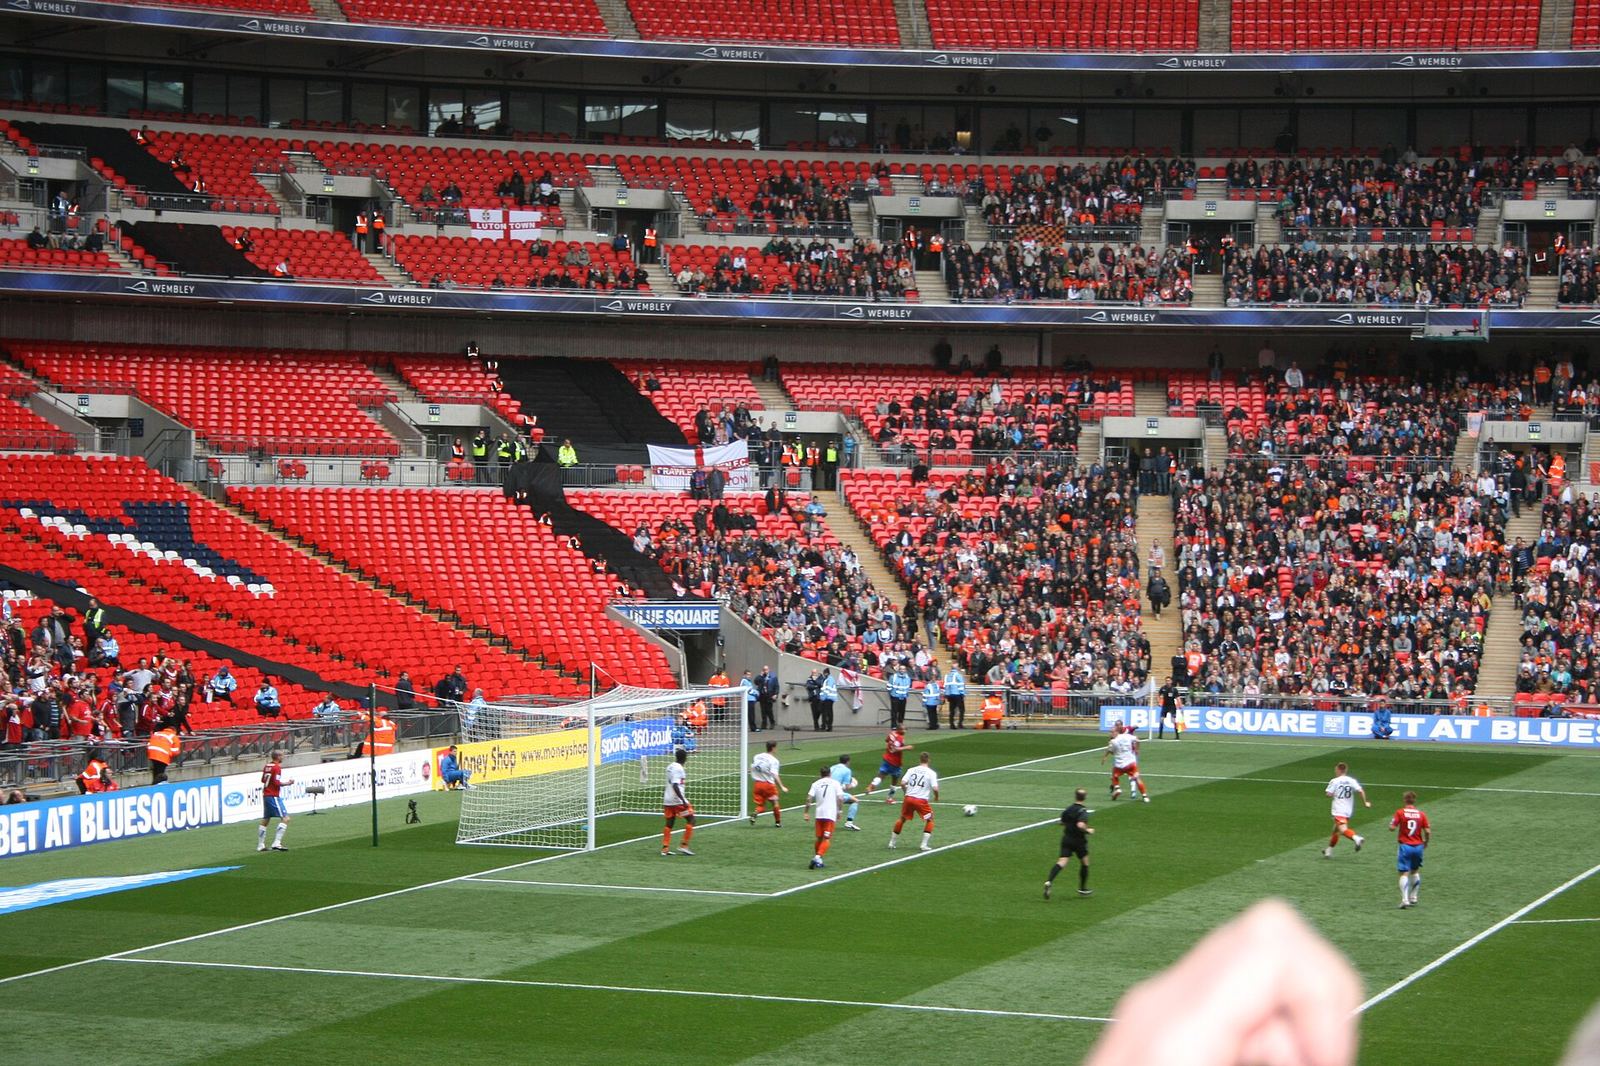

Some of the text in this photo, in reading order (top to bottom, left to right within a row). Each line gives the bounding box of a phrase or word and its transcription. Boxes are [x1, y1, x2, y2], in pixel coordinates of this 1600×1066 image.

[34, 2, 76, 13] WEMBLEY
[264, 23, 306, 34] WEMBLEY
[493, 39, 535, 49] WEMBLEY
[721, 50, 764, 59] WEMBLEY
[952, 57, 994, 65] WEMBLEY
[1183, 60, 1226, 68] WEMBLEY
[1418, 57, 1462, 66] WEMBLEY
[509, 222, 536, 230] TOWN
[151, 284, 195, 294] WEMBLEY
[388, 295, 433, 304] WEMBLEY
[627, 302, 672, 311] WEMBLEY
[867, 309, 912, 318] WEMBLEY
[1111, 313, 1156, 322] WEMBLEY
[1357, 315, 1402, 324] WEMBLEY
[665, 609, 720, 625] SQUARE
[1130, 708, 1200, 729] BLUE
[1205, 710, 1316, 733] SQUARE
[1429, 718, 1480, 739] AT
[1492, 720, 1600, 743] BLUE
[601, 733, 629, 757] sports
[457, 751, 488, 778] oney
[491, 745, 517, 775] Shop
[909, 773, 925, 788] 34
[821, 784, 829, 798] 7
[1337, 785, 1352, 799] 28
[0, 785, 220, 857] BET AT BLUESQ.COM
[1407, 819, 1417, 837] 9
